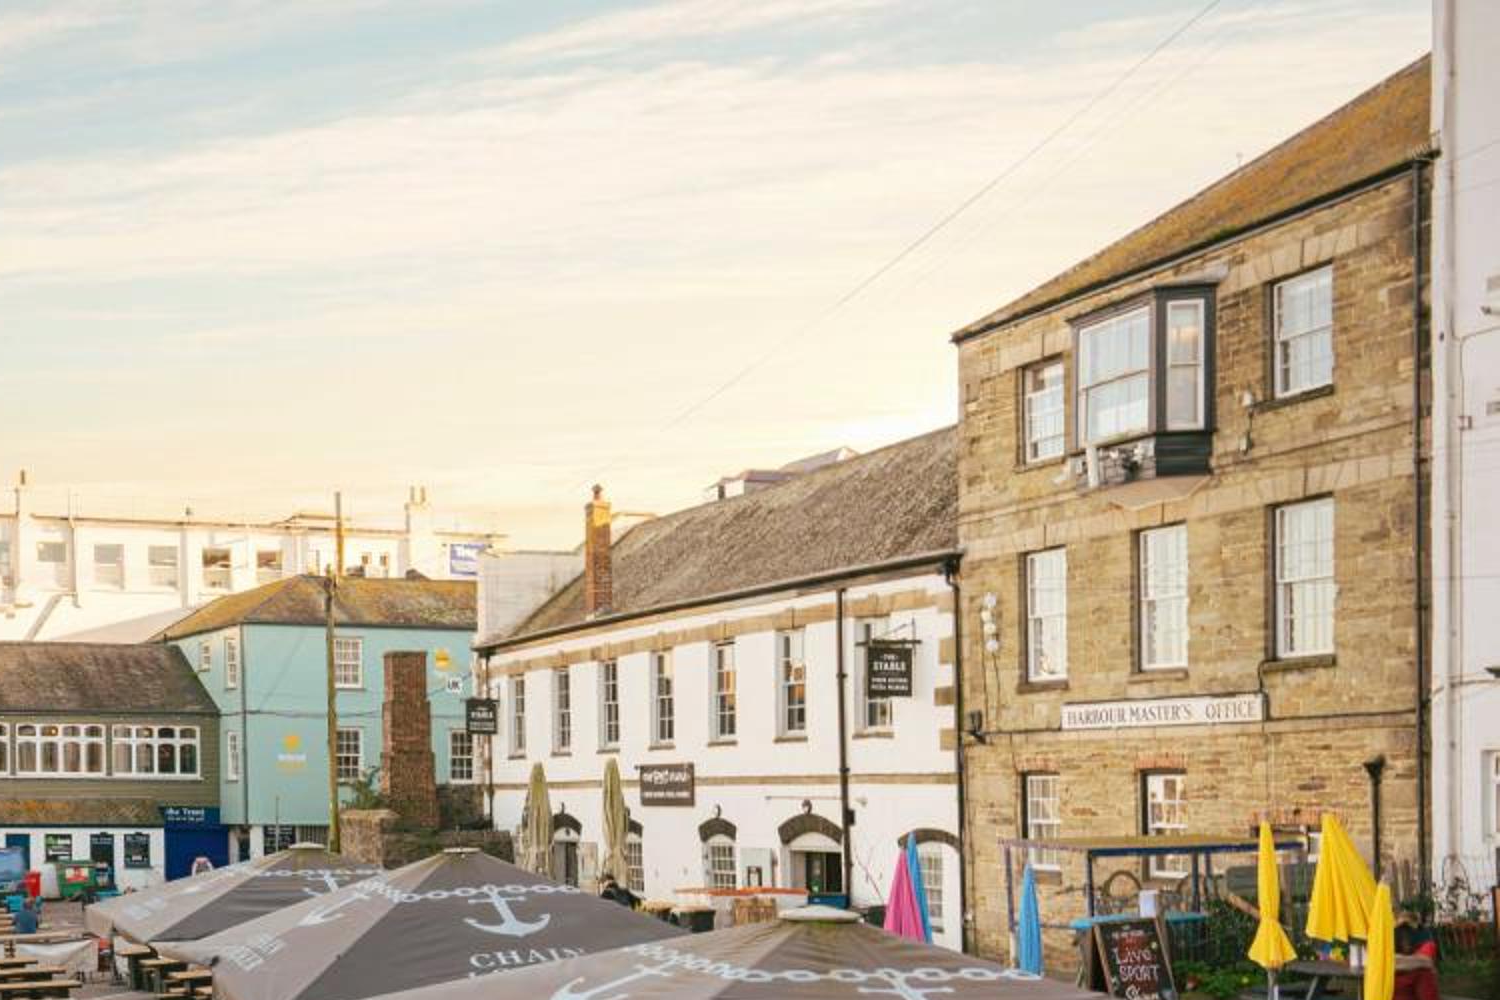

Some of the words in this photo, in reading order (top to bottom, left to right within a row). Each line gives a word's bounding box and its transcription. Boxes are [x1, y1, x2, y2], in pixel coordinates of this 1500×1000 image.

[1067, 709, 1125, 725] HARBOUR
[1129, 703, 1193, 721] MASTER'S
[1205, 699, 1257, 719] OFFICE
[1119, 965, 1159, 982] SPORT
